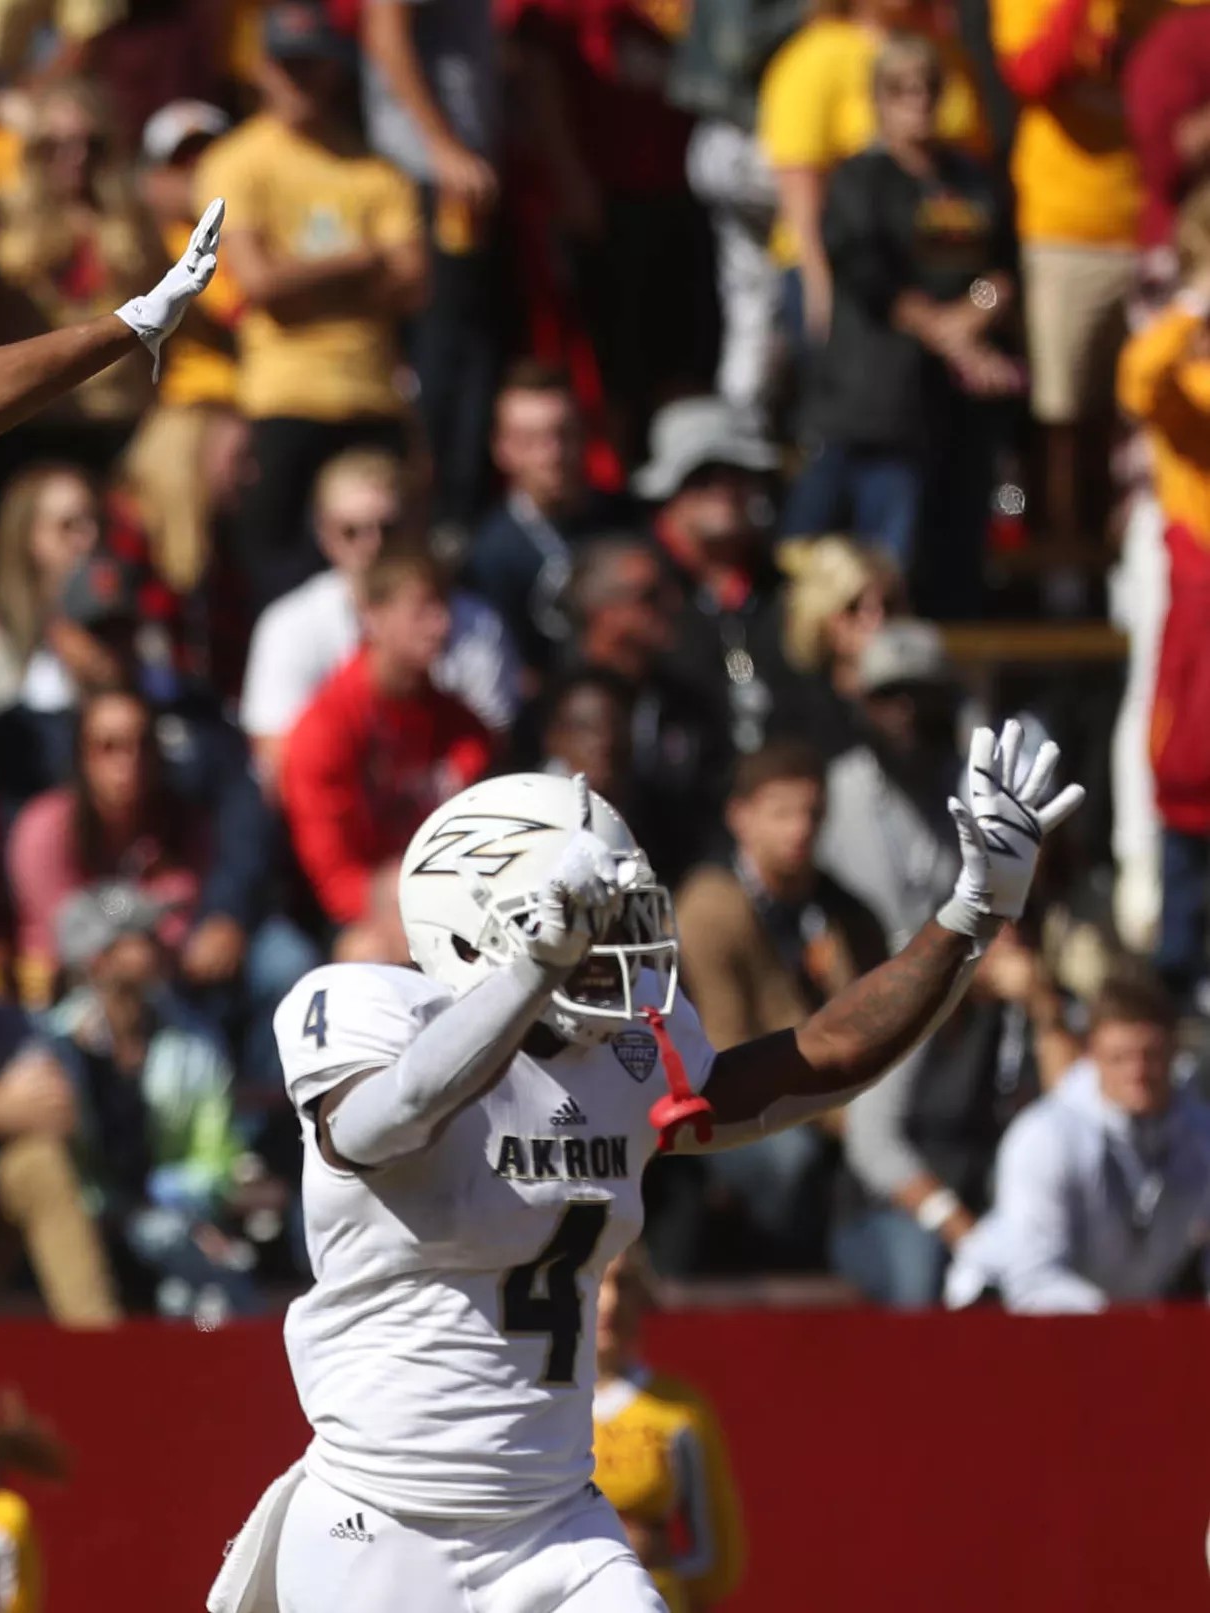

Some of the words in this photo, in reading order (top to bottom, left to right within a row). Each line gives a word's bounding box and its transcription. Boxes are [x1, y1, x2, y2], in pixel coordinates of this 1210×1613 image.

[301, 988, 329, 1050] 4
[495, 1134, 628, 1180] AKRON
[498, 1197, 611, 1387] 4
